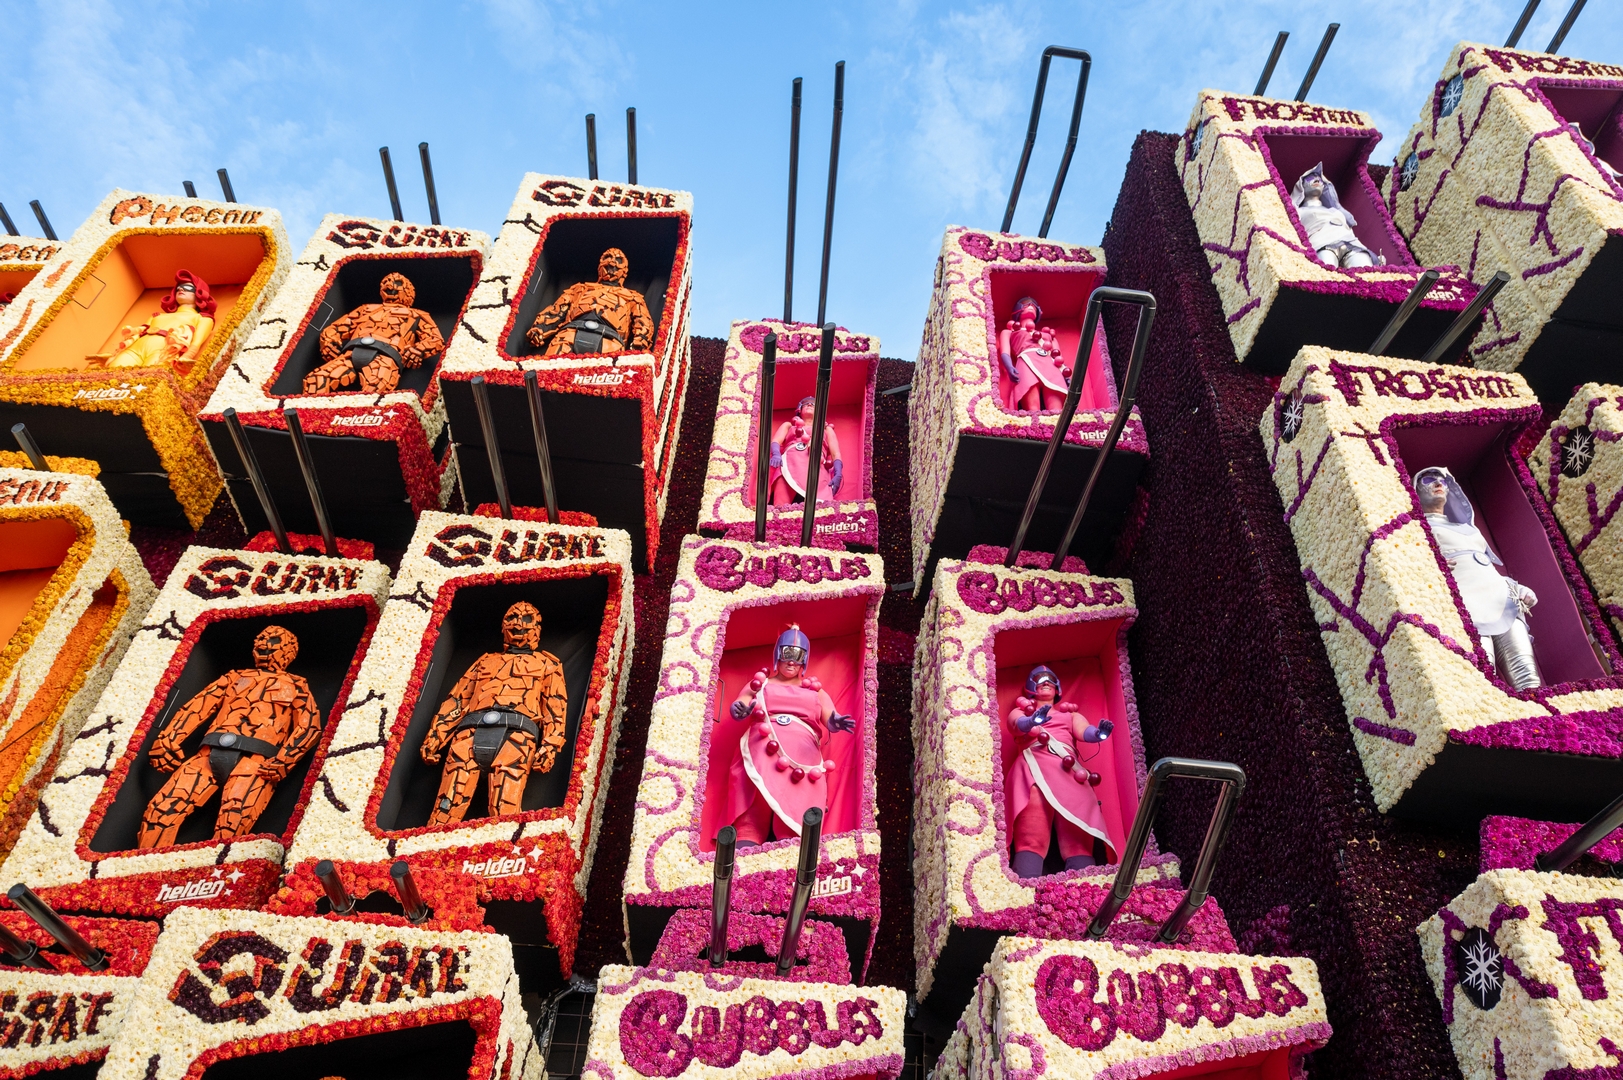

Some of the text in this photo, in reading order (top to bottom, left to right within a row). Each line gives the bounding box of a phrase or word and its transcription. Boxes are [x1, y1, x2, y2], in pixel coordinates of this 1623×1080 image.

[1221, 97, 1366, 126] FROSTBITE
[534, 180, 676, 208] QUAKE
[327, 220, 471, 249] QUAKE
[959, 232, 1096, 263] BUBBLES
[73, 387, 131, 401] helden
[573, 372, 625, 386] helden
[1329, 359, 1519, 408] FROSTBITE
[331, 413, 384, 428] helden
[816, 523, 860, 535] helden
[425, 523, 606, 569] QUAKE
[184, 556, 363, 601] QUAKE
[694, 544, 871, 593] BUBBLES
[957, 571, 1125, 614] BUBBLES
[462, 857, 528, 878] helden
[156, 879, 226, 903] helden
[168, 930, 472, 1026] QUAKE
[1035, 954, 1307, 1052] BUBBLES
[619, 988, 884, 1076] BUBBLES
